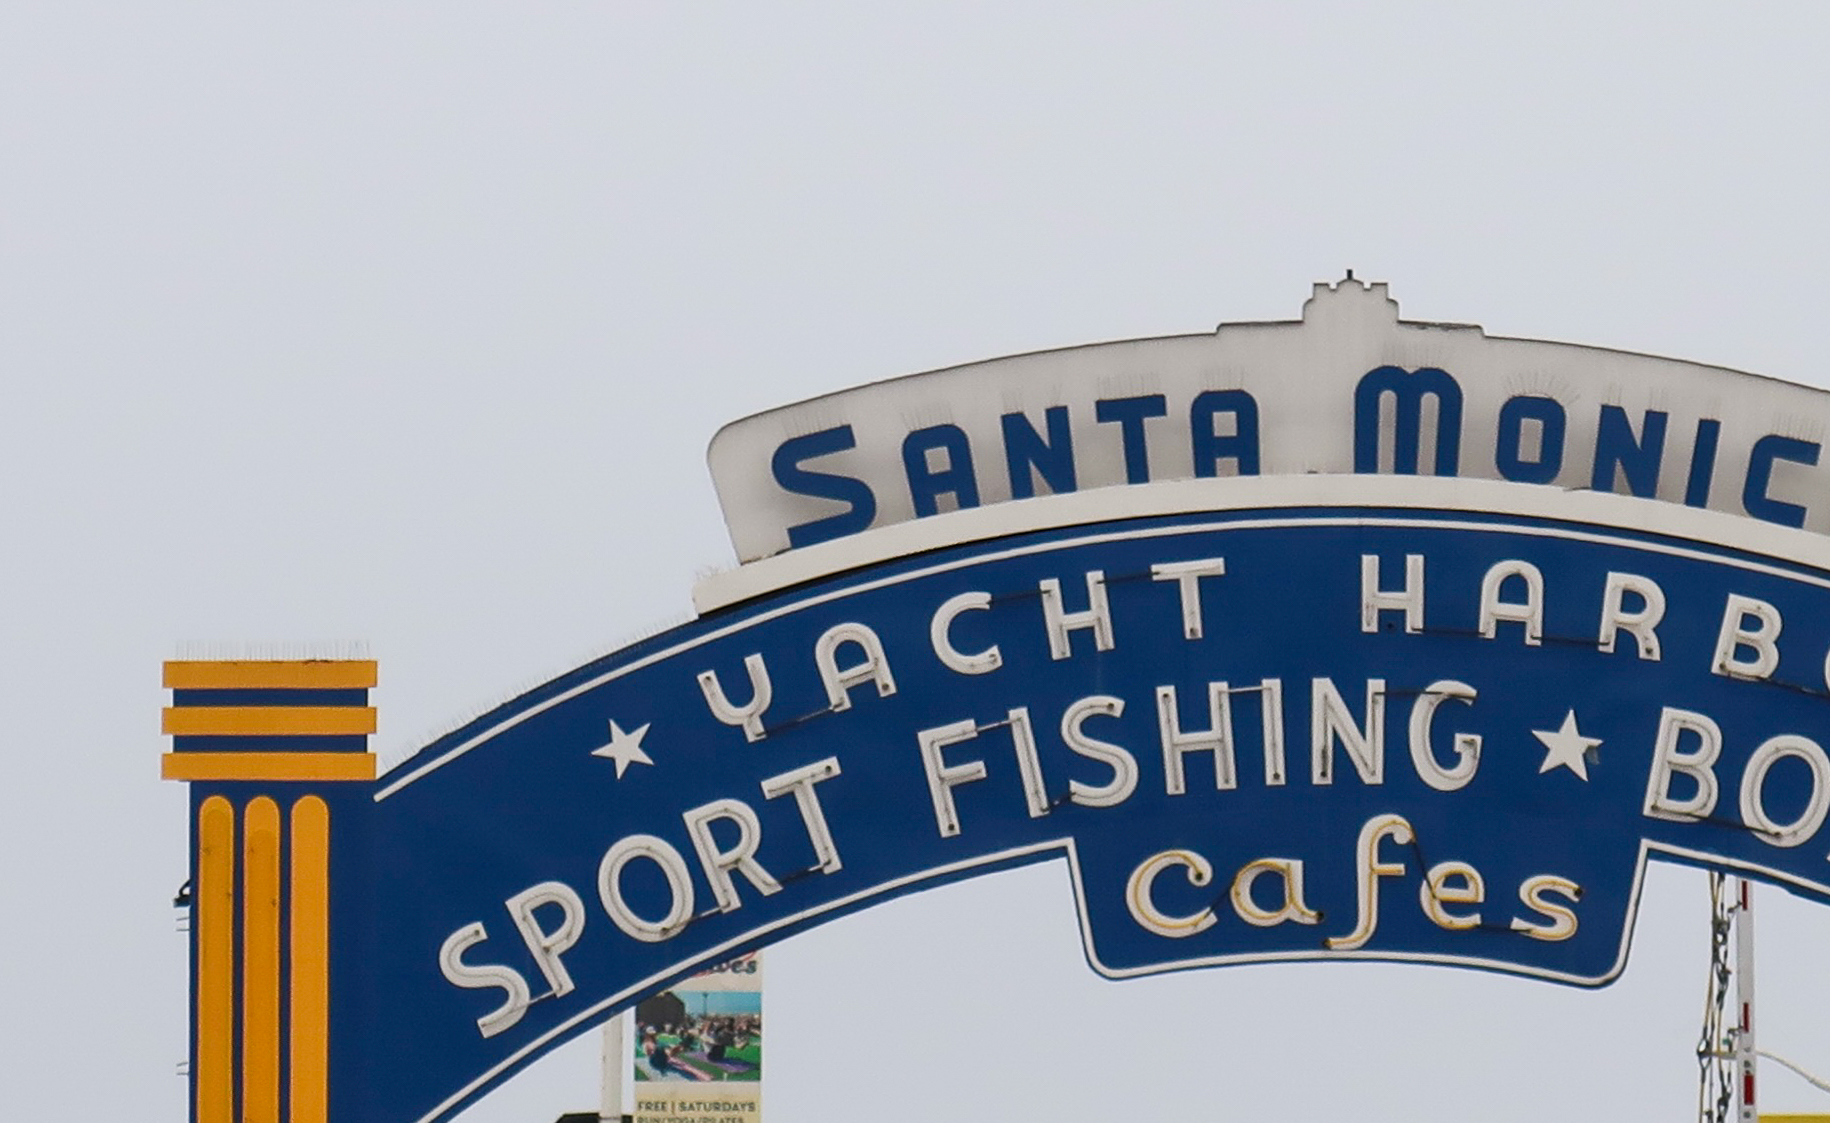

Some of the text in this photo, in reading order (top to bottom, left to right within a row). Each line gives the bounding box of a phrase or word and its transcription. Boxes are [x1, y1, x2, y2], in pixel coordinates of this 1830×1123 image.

[771, 390, 1260, 550] SANTA
[697, 558, 1225, 743] YACHT
[439, 756, 842, 1038] SPORT
[917, 678, 1482, 838] FISHING
[638, 1102, 667, 1112] FREE
[679, 1102, 755, 1112] SATURDAYS
